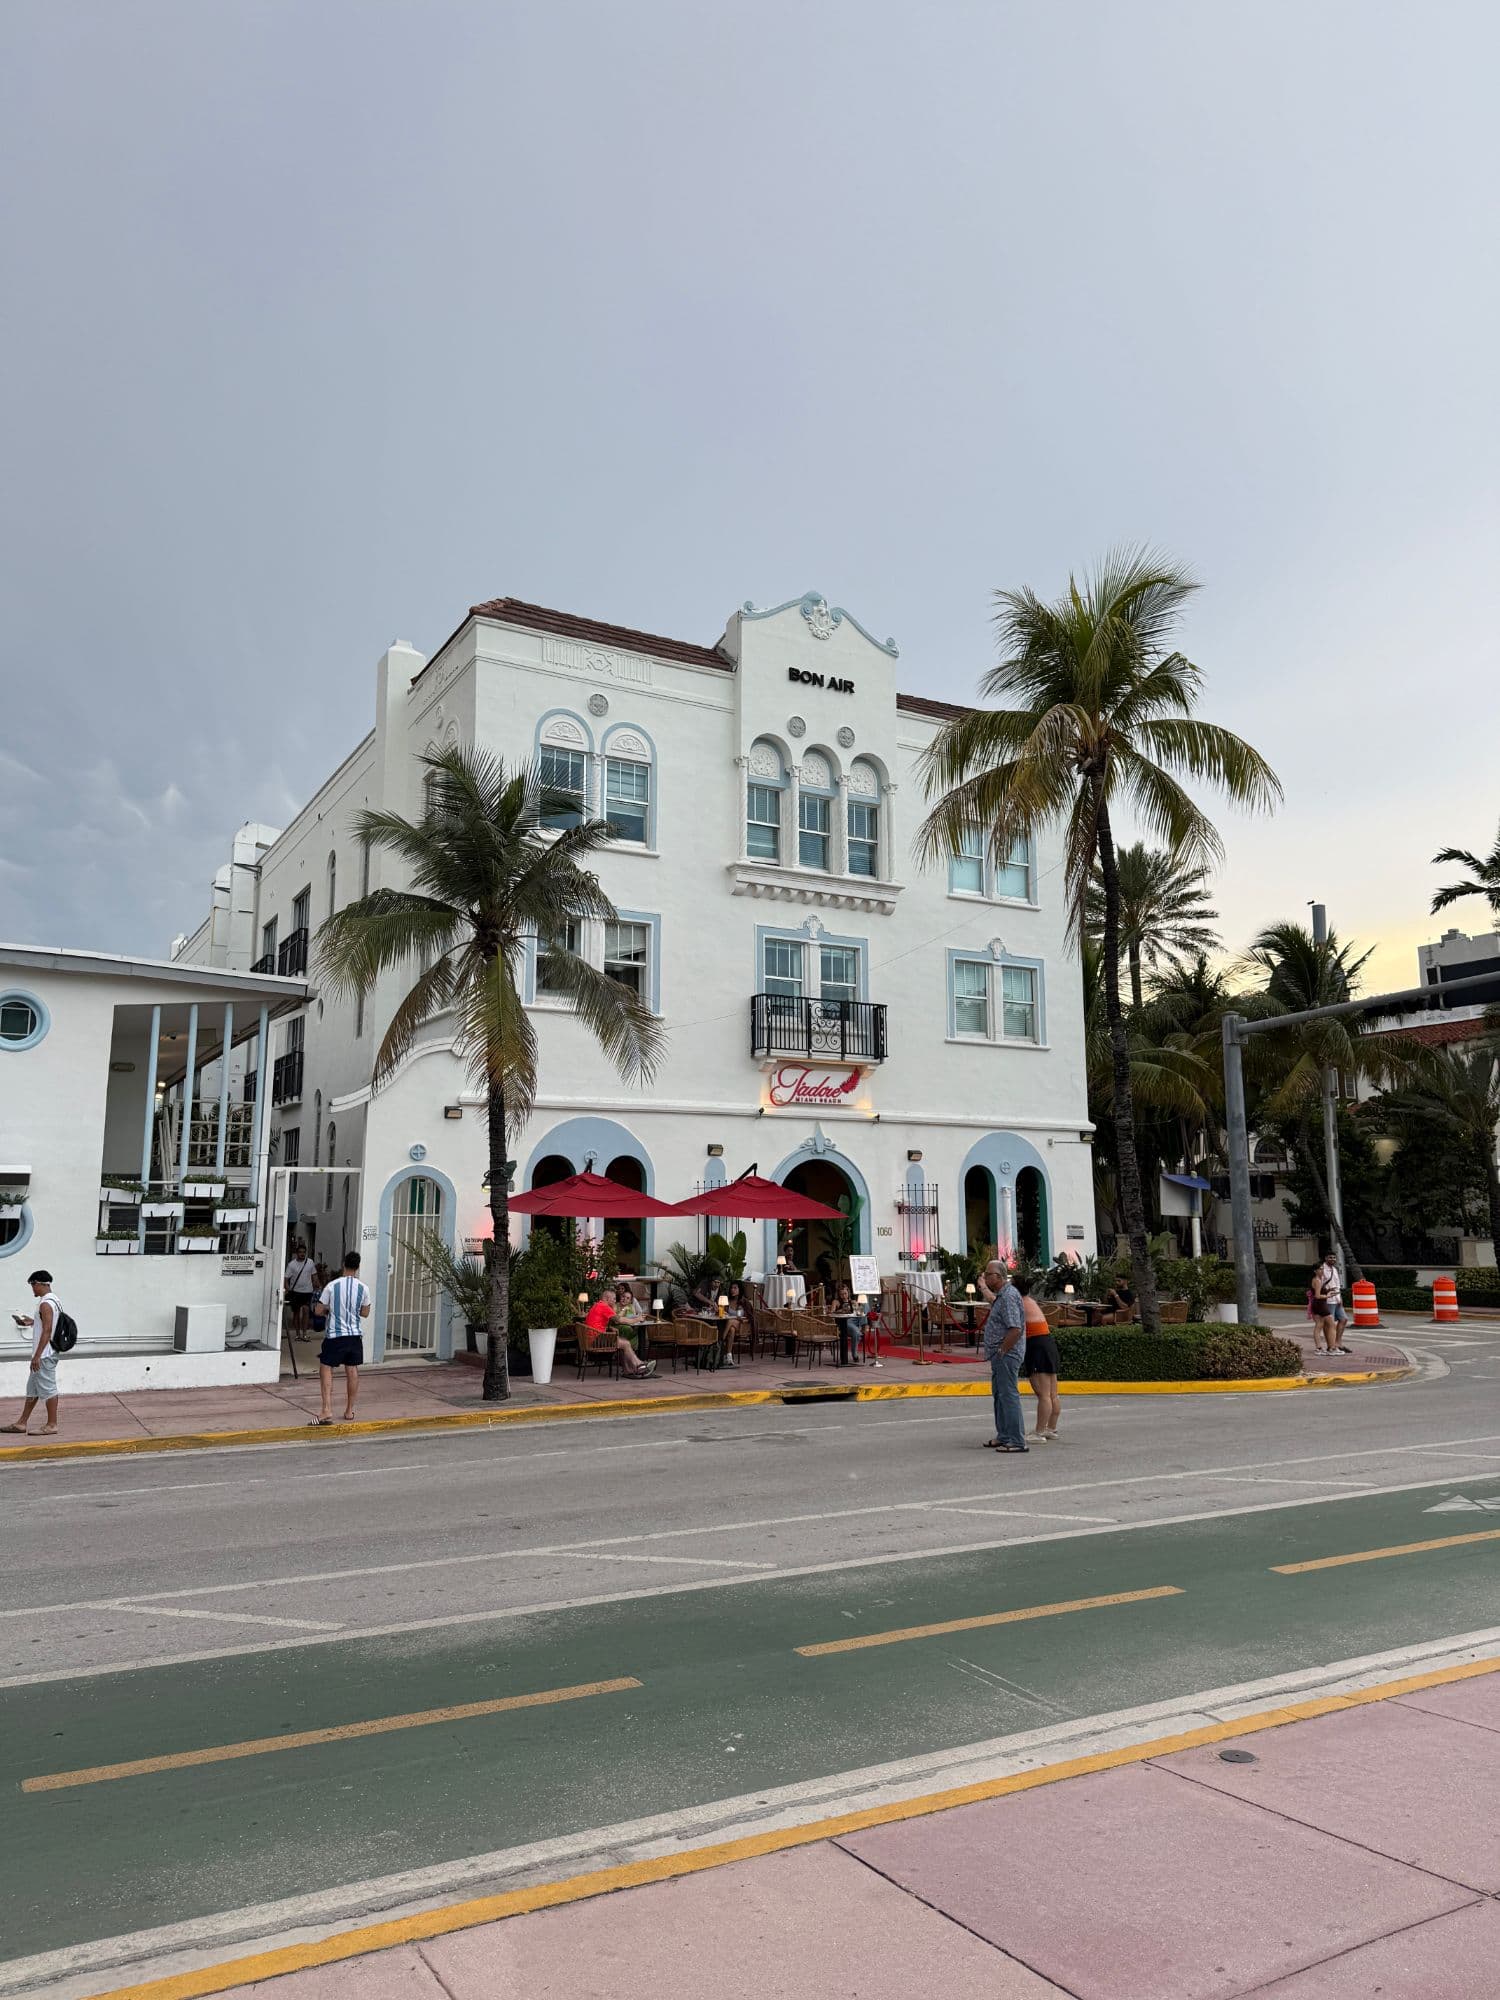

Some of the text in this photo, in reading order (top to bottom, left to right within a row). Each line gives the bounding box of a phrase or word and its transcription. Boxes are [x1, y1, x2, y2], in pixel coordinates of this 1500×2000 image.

[789, 667, 855, 693] BON AIR
[877, 1226, 892, 1237] 1060
